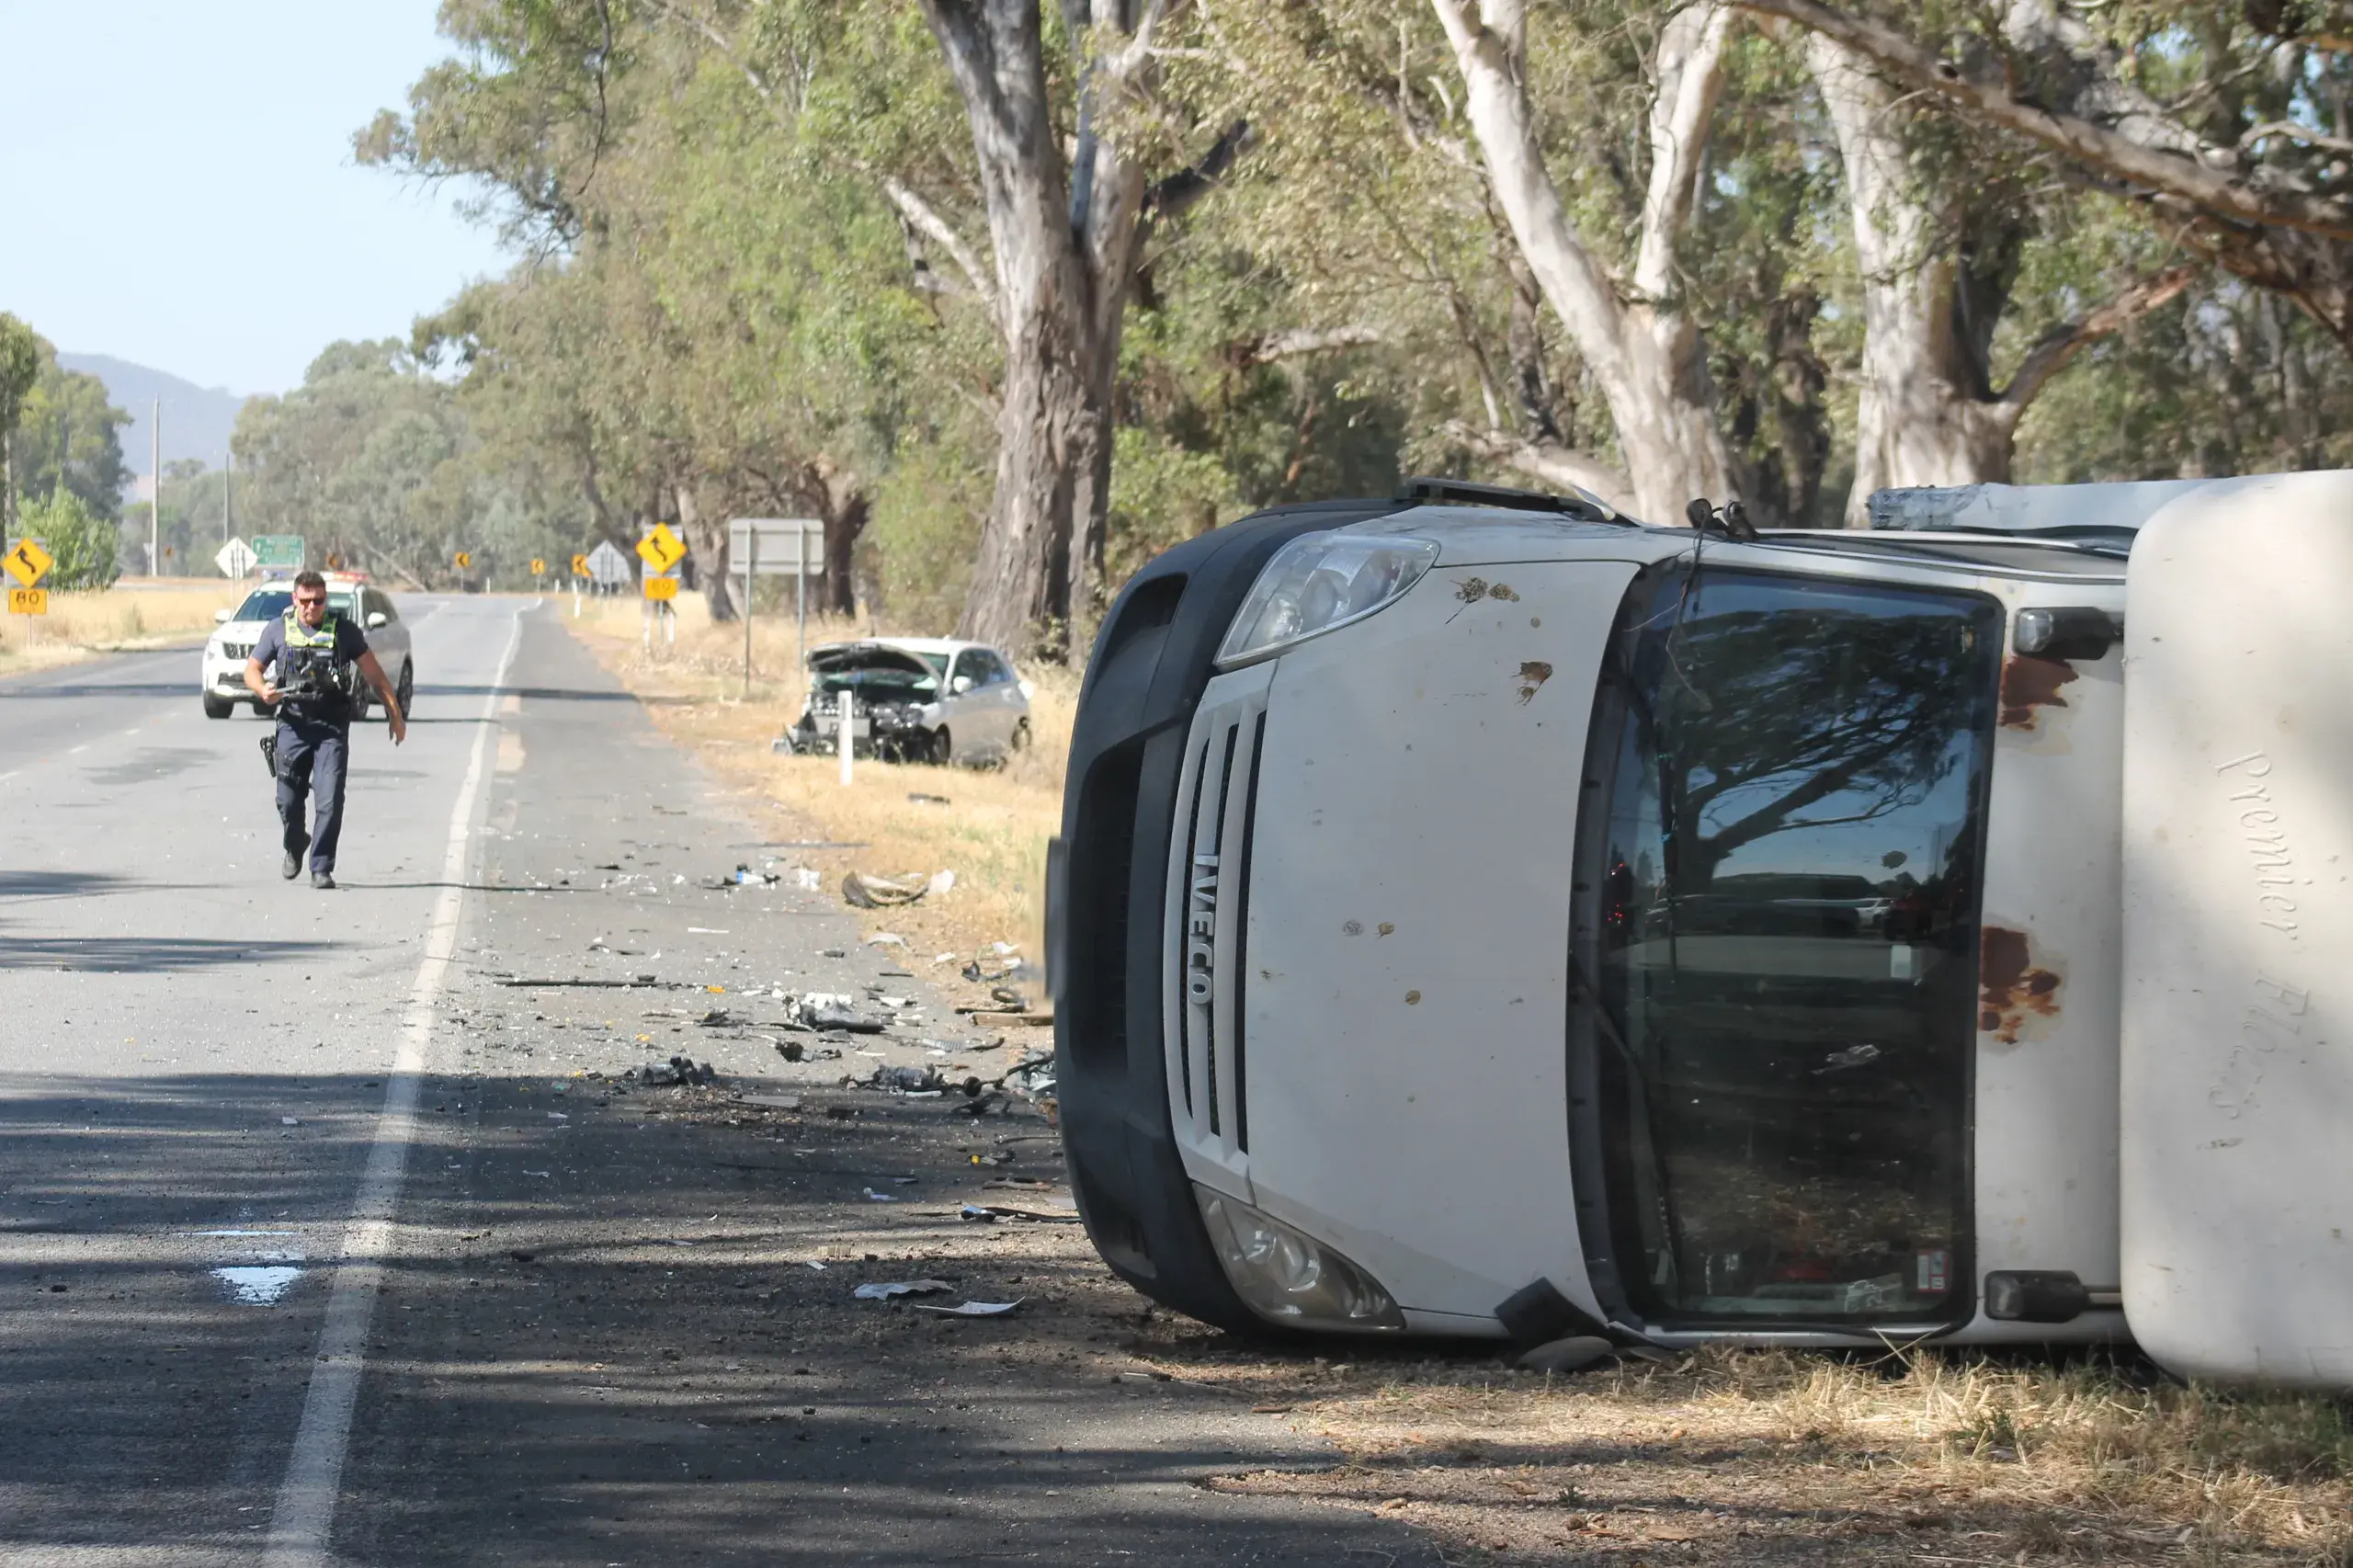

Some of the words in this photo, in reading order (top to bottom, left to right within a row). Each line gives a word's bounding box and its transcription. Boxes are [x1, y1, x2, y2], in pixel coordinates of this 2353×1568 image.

[16, 591, 40, 604] 80
[2215, 750, 2313, 940] Premier
[1188, 855, 1219, 1004] IVECO
